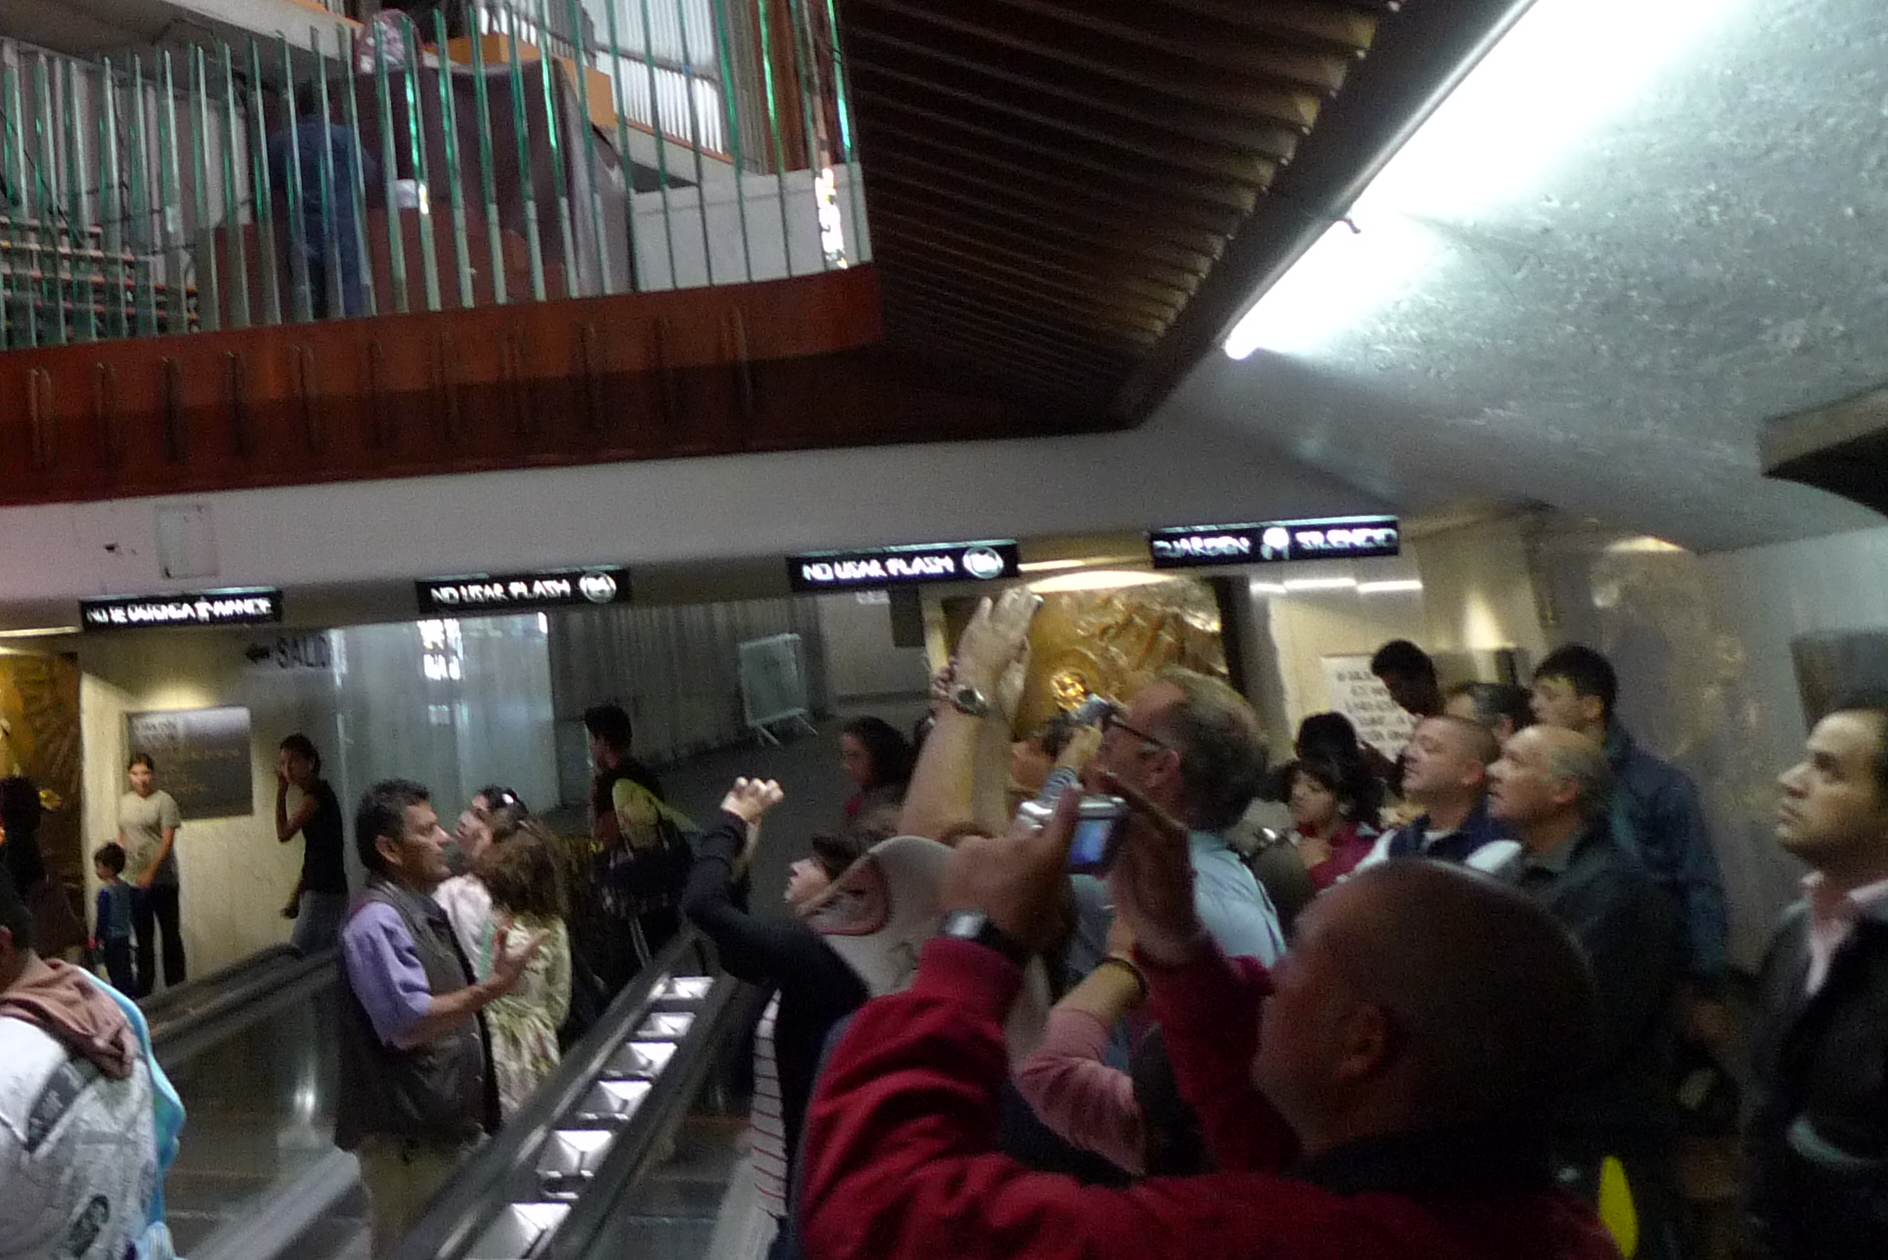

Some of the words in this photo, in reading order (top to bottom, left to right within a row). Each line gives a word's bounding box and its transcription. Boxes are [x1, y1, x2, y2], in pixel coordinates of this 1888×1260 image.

[1295, 528, 1398, 550] SILENCIO
[802, 562, 834, 581] NO
[834, 559, 888, 580] USAR
[886, 555, 955, 576] FLASH
[430, 585, 459, 604] NO
[460, 582, 509, 604] USAR
[508, 579, 571, 600] FLASH
